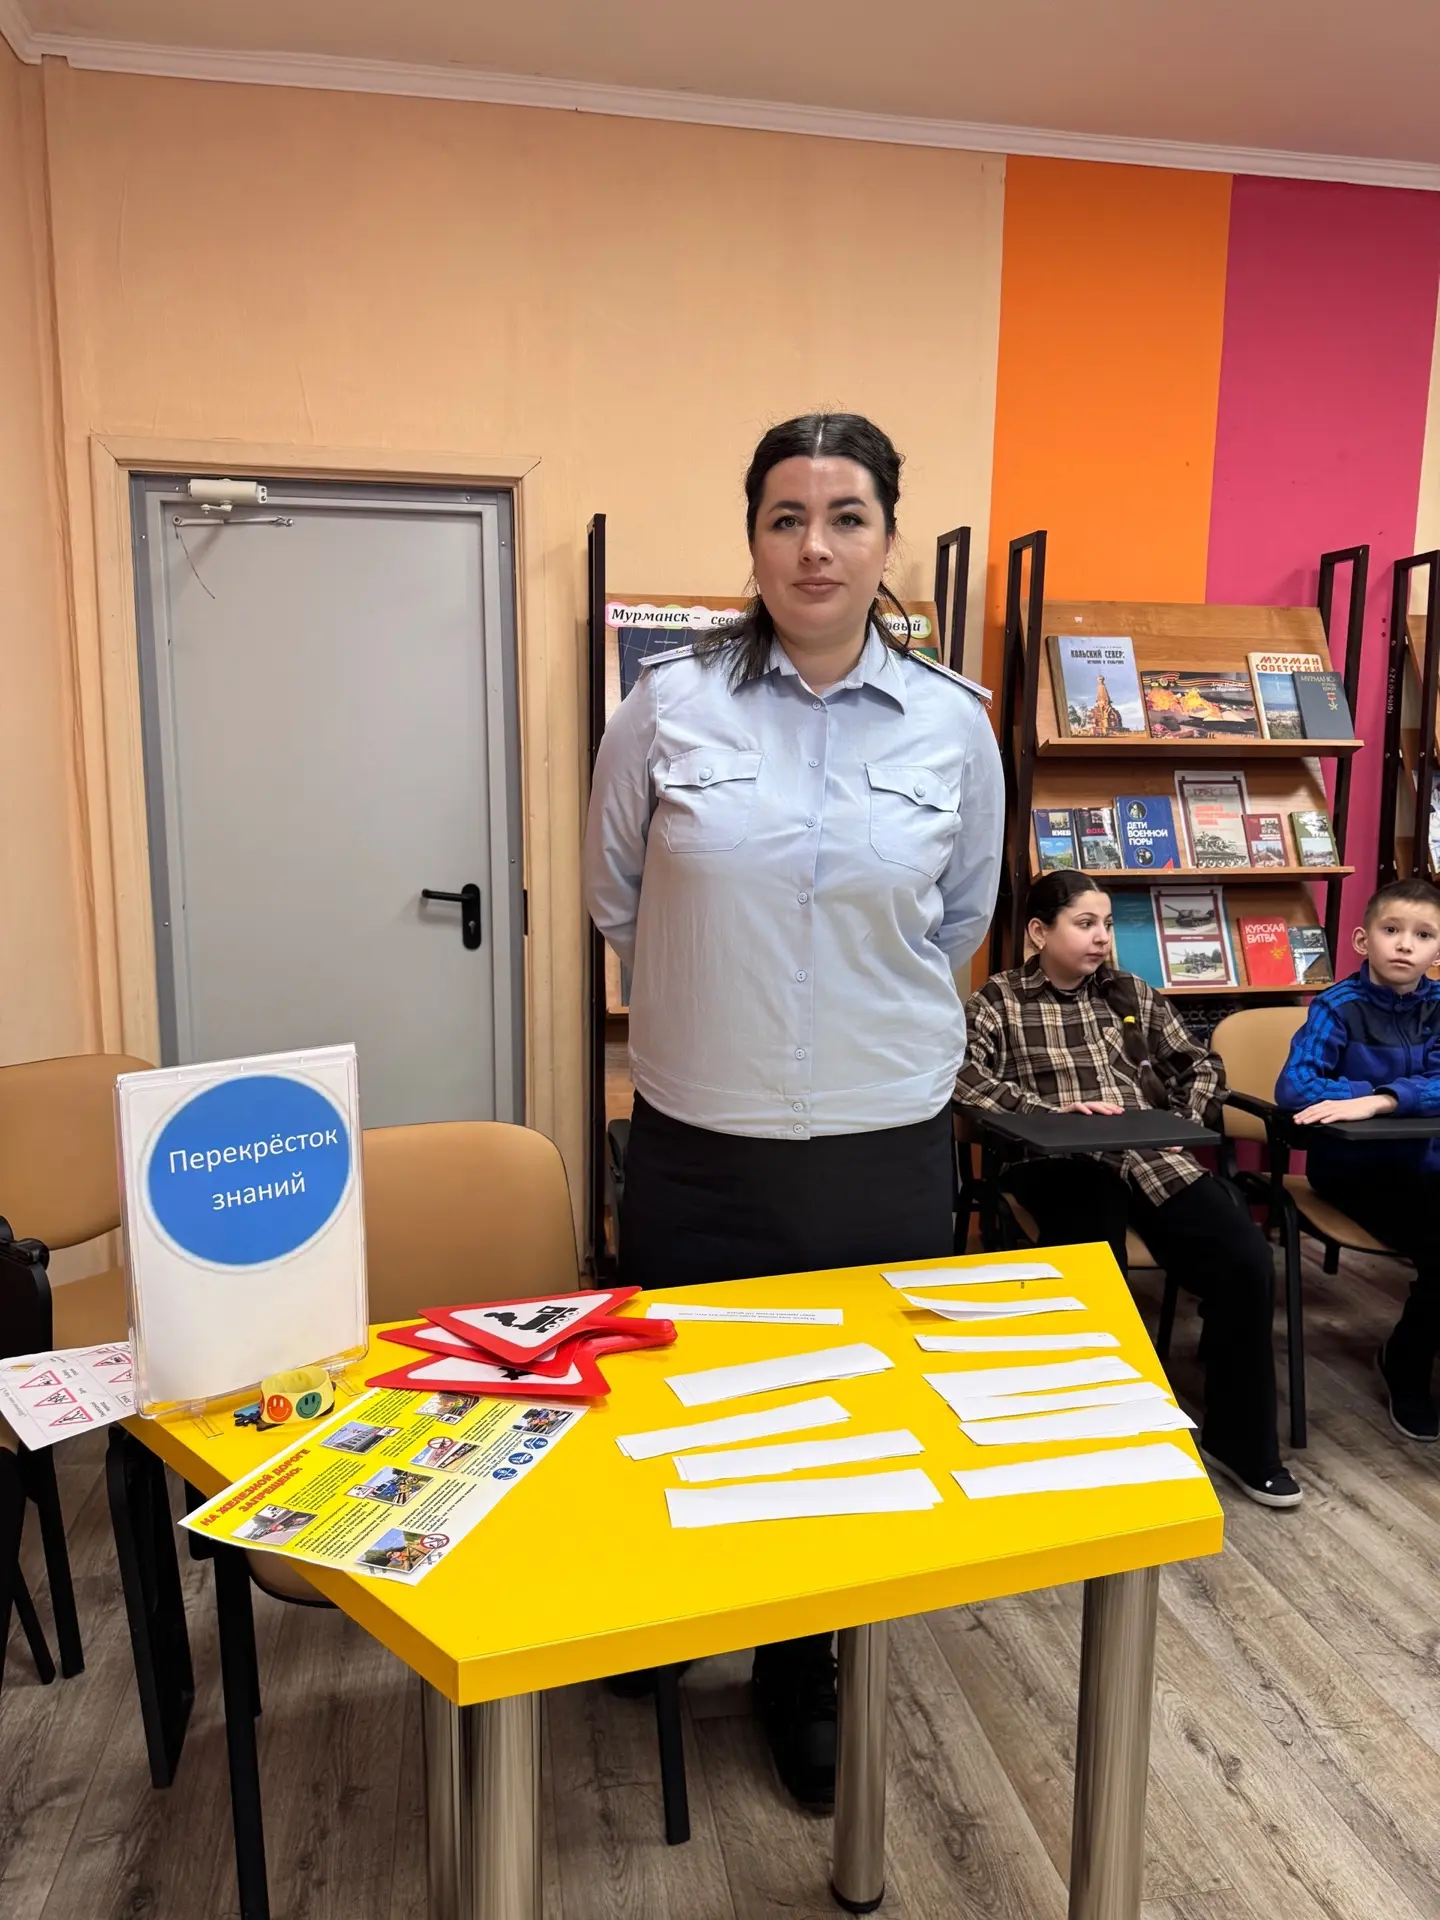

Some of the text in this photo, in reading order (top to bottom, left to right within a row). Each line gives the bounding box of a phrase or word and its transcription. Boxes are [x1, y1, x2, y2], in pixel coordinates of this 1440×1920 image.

[611, 608, 690, 624] Мурманск
[1260, 656, 1319, 665] МУРМАН
[1127, 822, 1148, 830] ДЕТИ
[1128, 829, 1168, 838] ВОЕННОЙ
[1129, 837, 1153, 846] ПОРЫ
[1245, 923, 1285, 934] КУРСКАЯ
[1246, 933, 1278, 944] БИТВА
[169, 1127, 338, 1176] Перекрёсток
[212, 1171, 306, 1211] знаний
[200, 1513, 221, 1527] НА
